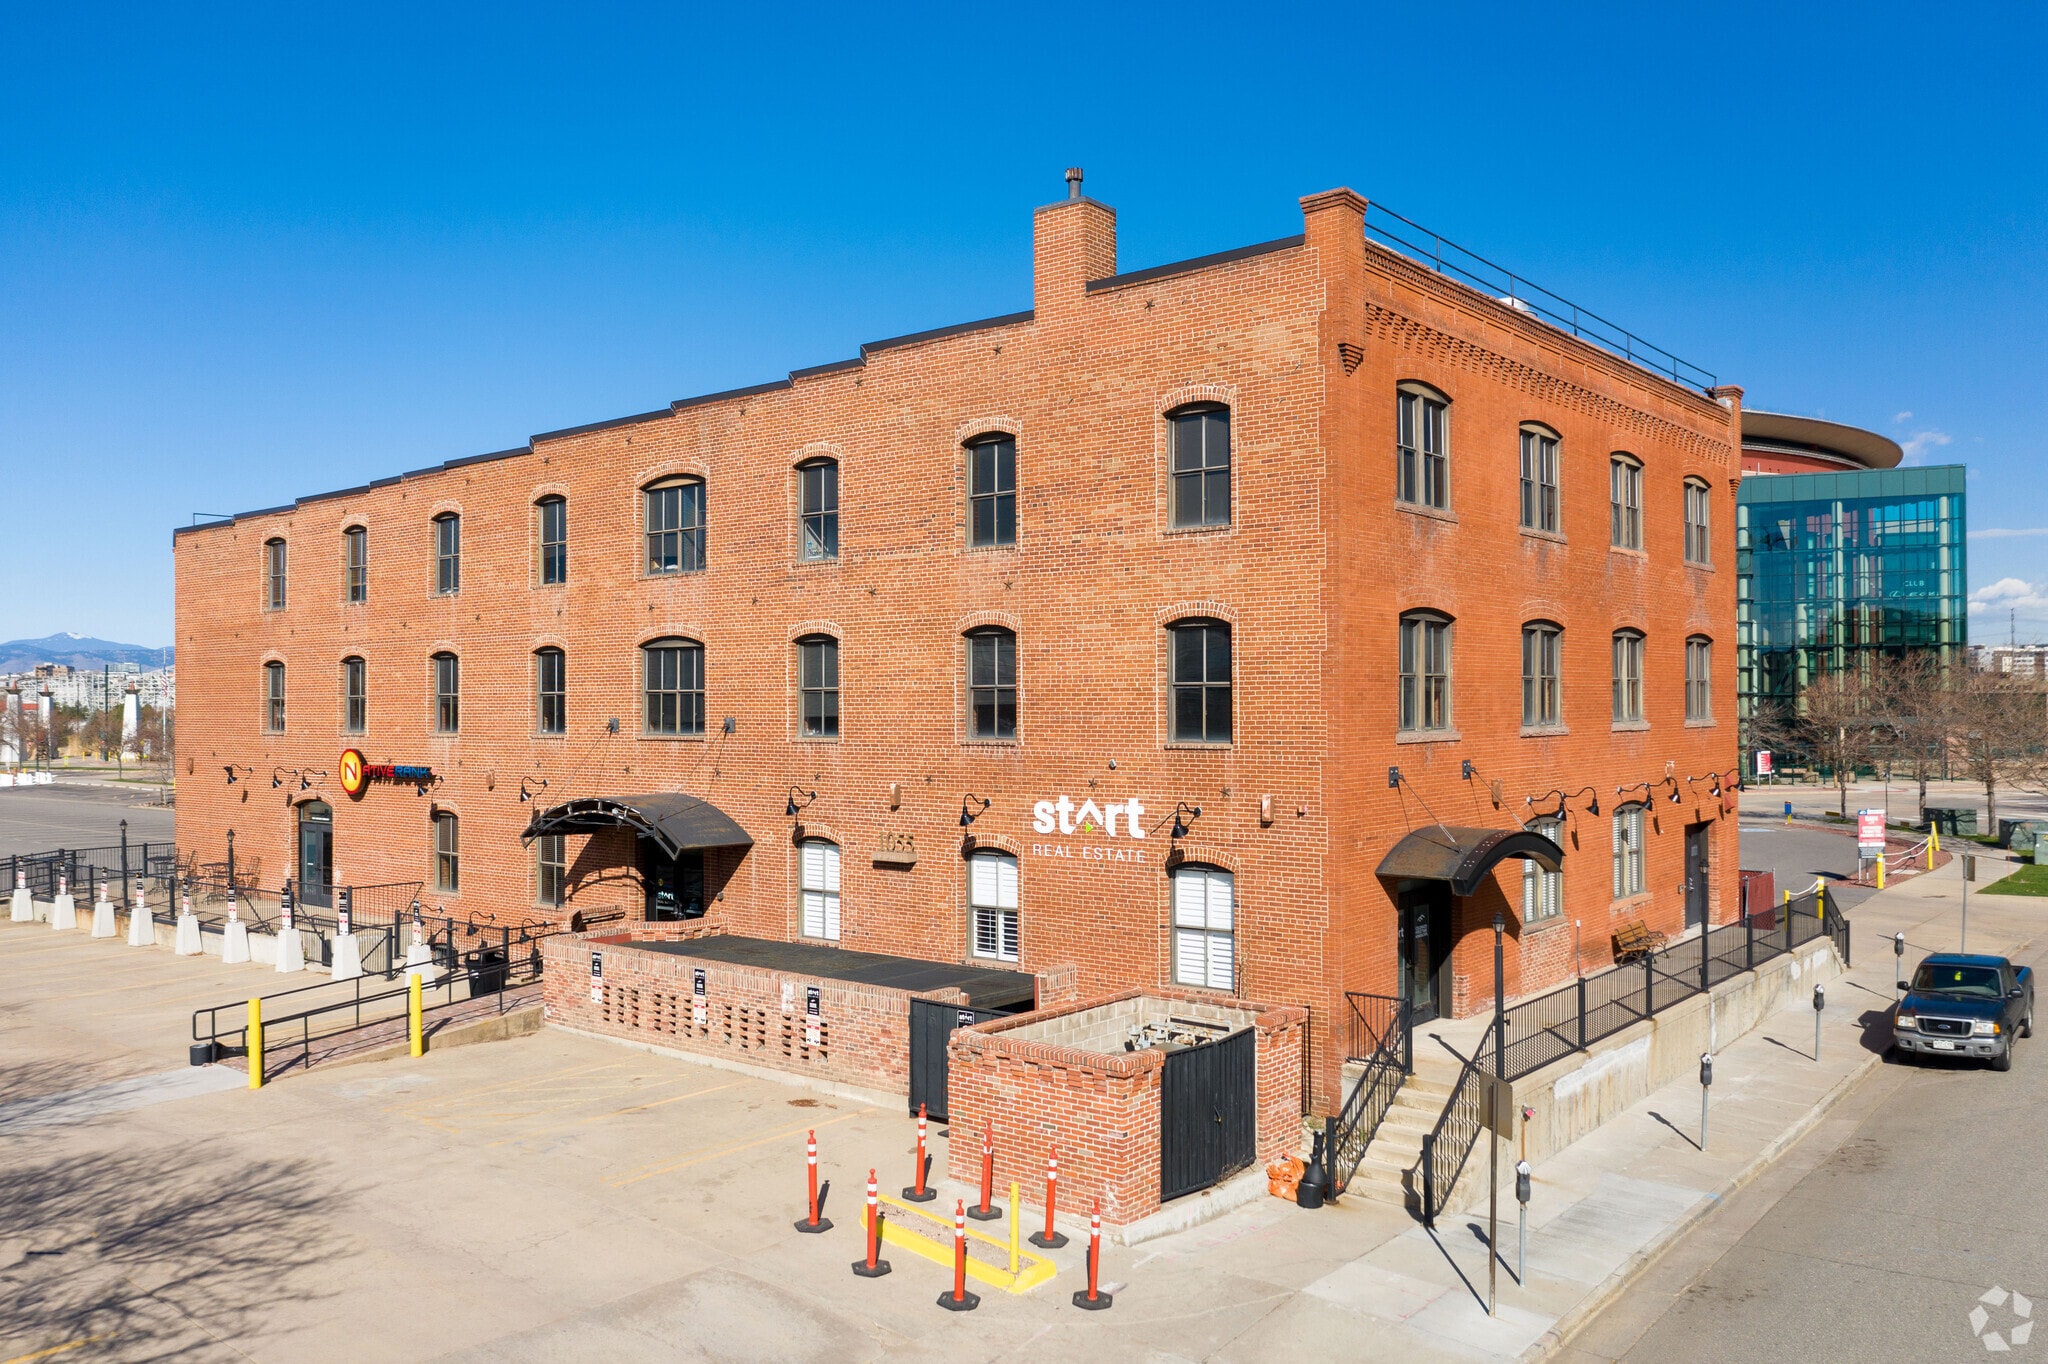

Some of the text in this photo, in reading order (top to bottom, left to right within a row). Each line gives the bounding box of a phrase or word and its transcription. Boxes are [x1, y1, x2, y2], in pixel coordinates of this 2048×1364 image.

[879, 830, 914, 852] 1055
[1033, 844, 1145, 863] REAL ESTATE
